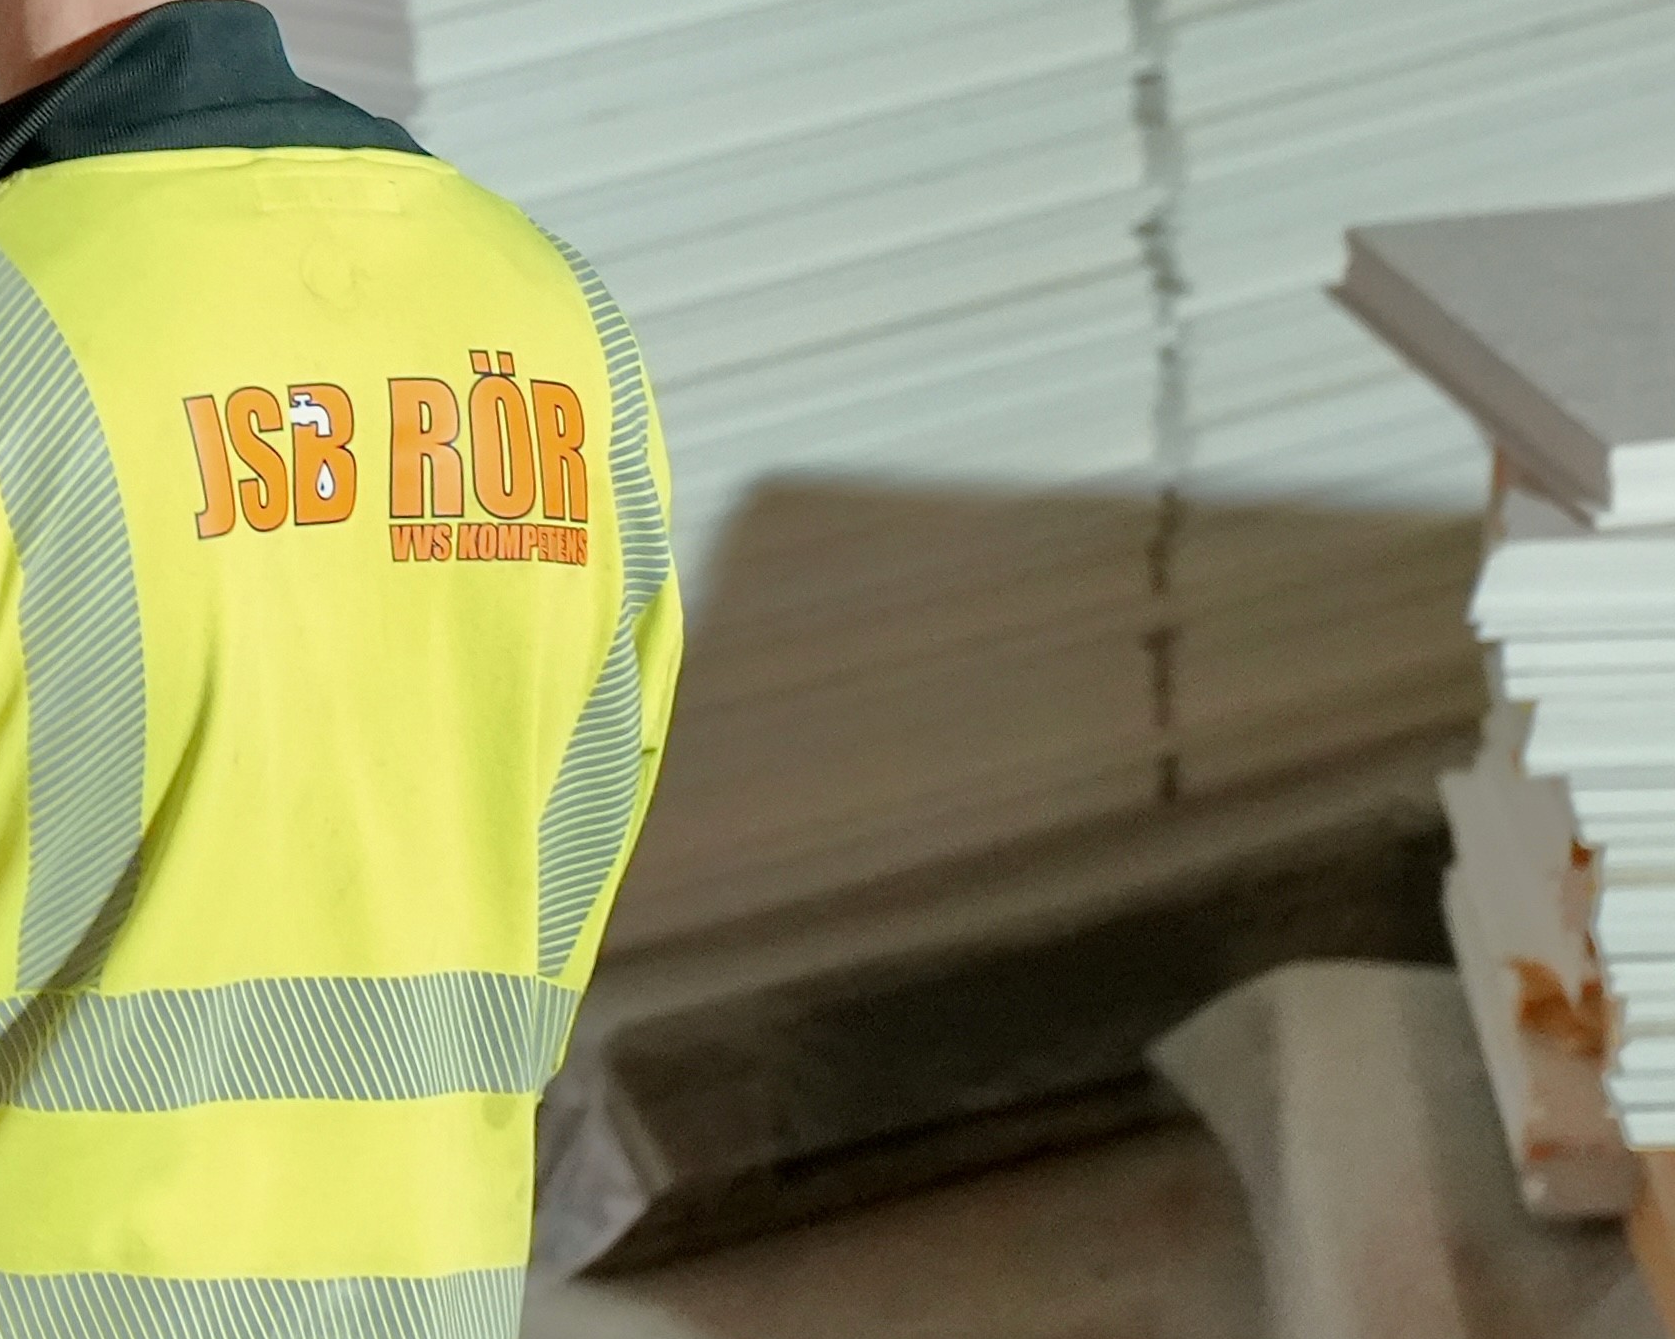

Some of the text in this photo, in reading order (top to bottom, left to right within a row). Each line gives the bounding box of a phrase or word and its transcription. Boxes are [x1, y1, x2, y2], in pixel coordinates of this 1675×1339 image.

[183, 350, 589, 540] JSB RÖR
[389, 522, 588, 567] VVS KOMPETENS
